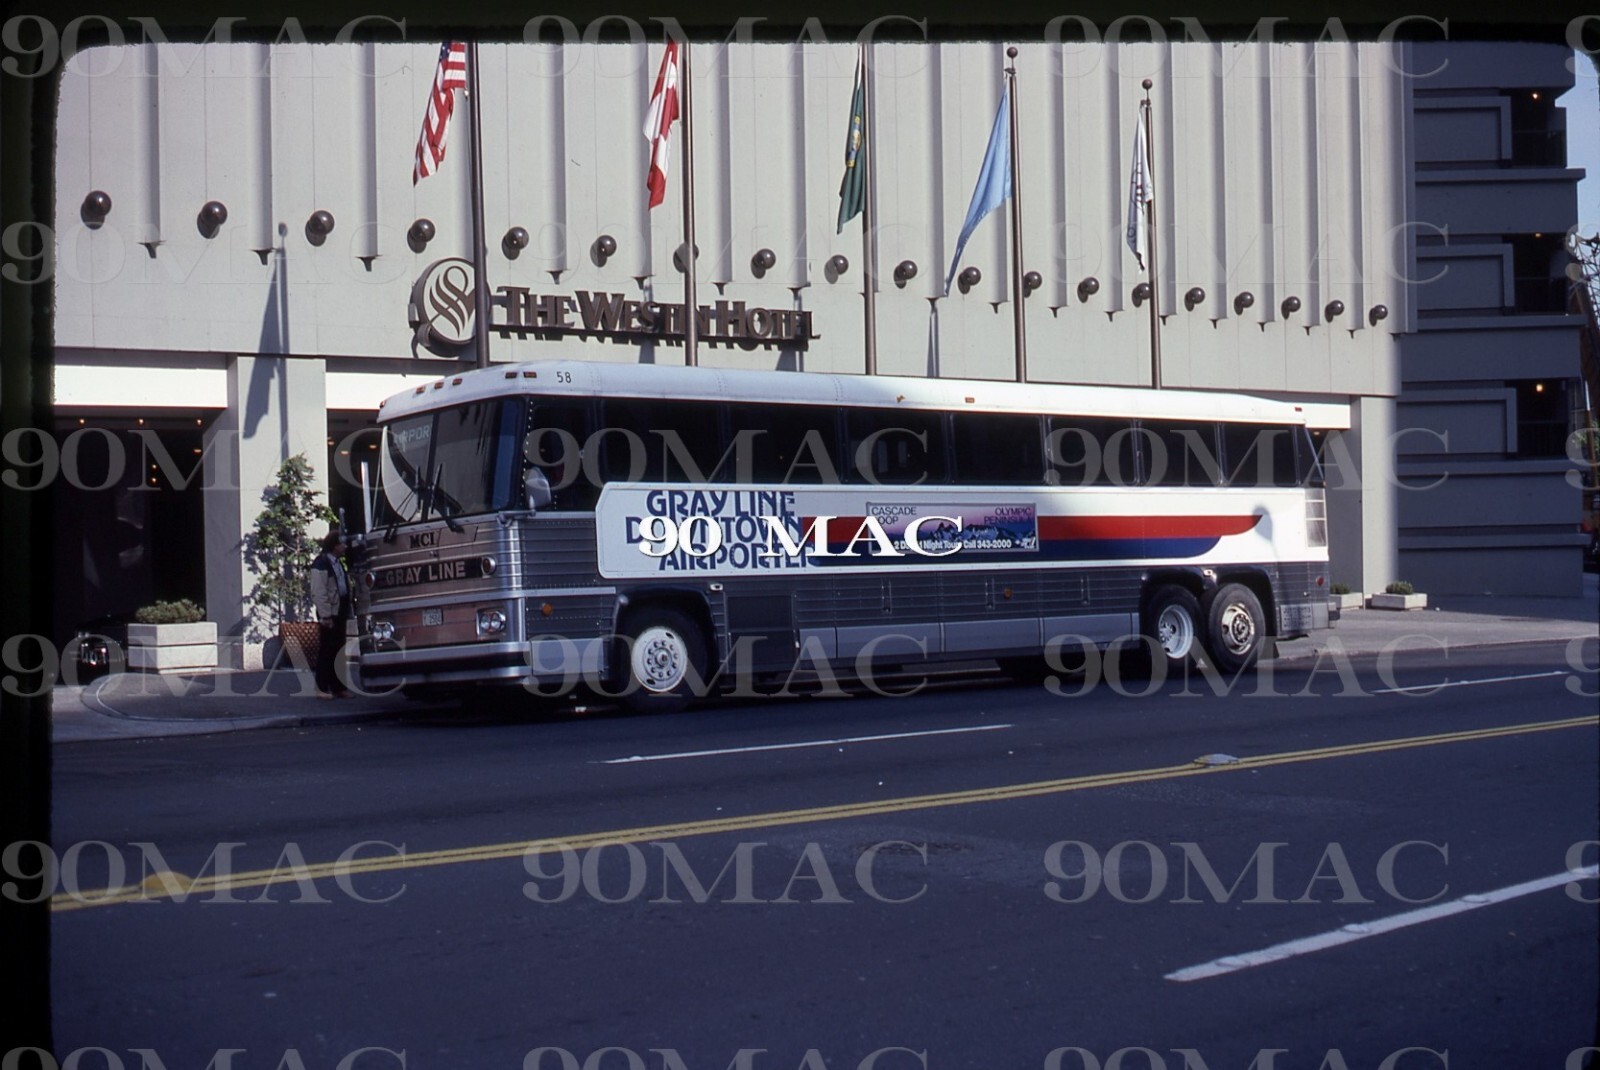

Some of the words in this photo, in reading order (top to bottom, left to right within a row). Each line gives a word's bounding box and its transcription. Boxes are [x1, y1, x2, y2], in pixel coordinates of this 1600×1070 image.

[497, 286, 575, 327] THE
[715, 300, 821, 340] HOTEL
[556, 371, 572, 383] 58
[646, 490, 728, 519] GRAY
[735, 491, 795, 517] LINE
[871, 506, 917, 516] CASCADE
[994, 507, 1032, 516] OLYMPIC
[876, 516, 899, 525] OOP
[409, 532, 436, 548] MCI
[977, 539, 1012, 549] 343-2000
[386, 567, 422, 585] GRAY
[428, 561, 466, 580] LINE
